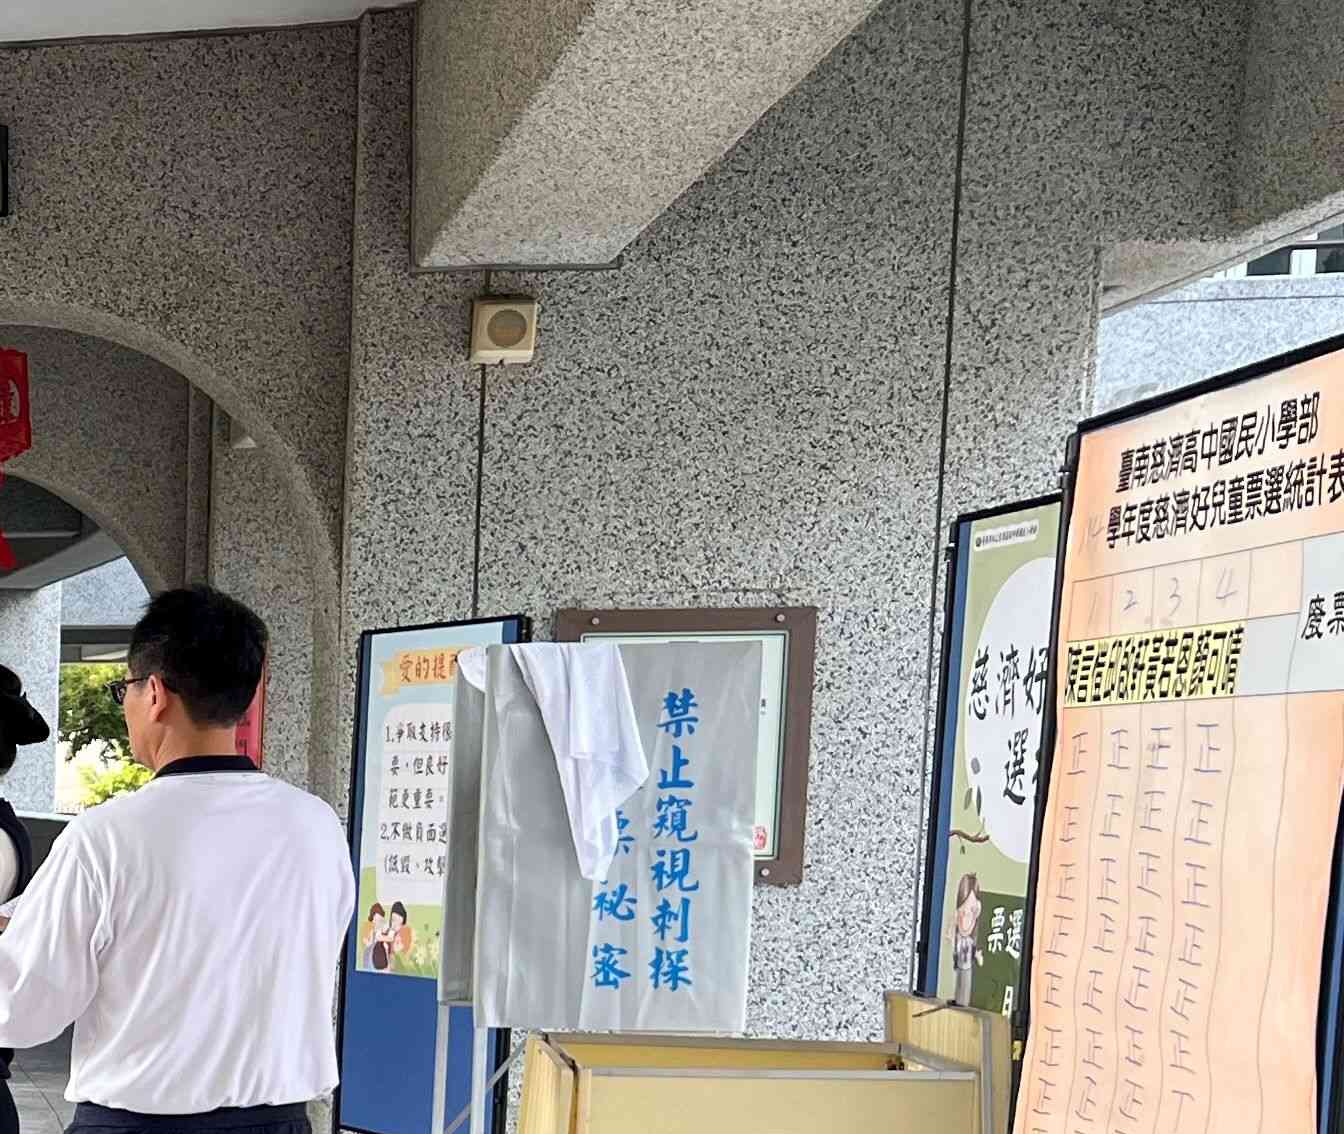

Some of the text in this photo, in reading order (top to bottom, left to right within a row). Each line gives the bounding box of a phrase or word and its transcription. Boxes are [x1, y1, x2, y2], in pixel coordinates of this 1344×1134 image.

[1116, 391, 1321, 494] 臺南慈濟高中國民小學部
[1123, 589, 1139, 612] 2
[1169, 576, 1185, 618] 3
[969, 643, 1049, 721] 慈濟好
[648, 688, 700, 993] 禁止窺視刺探
